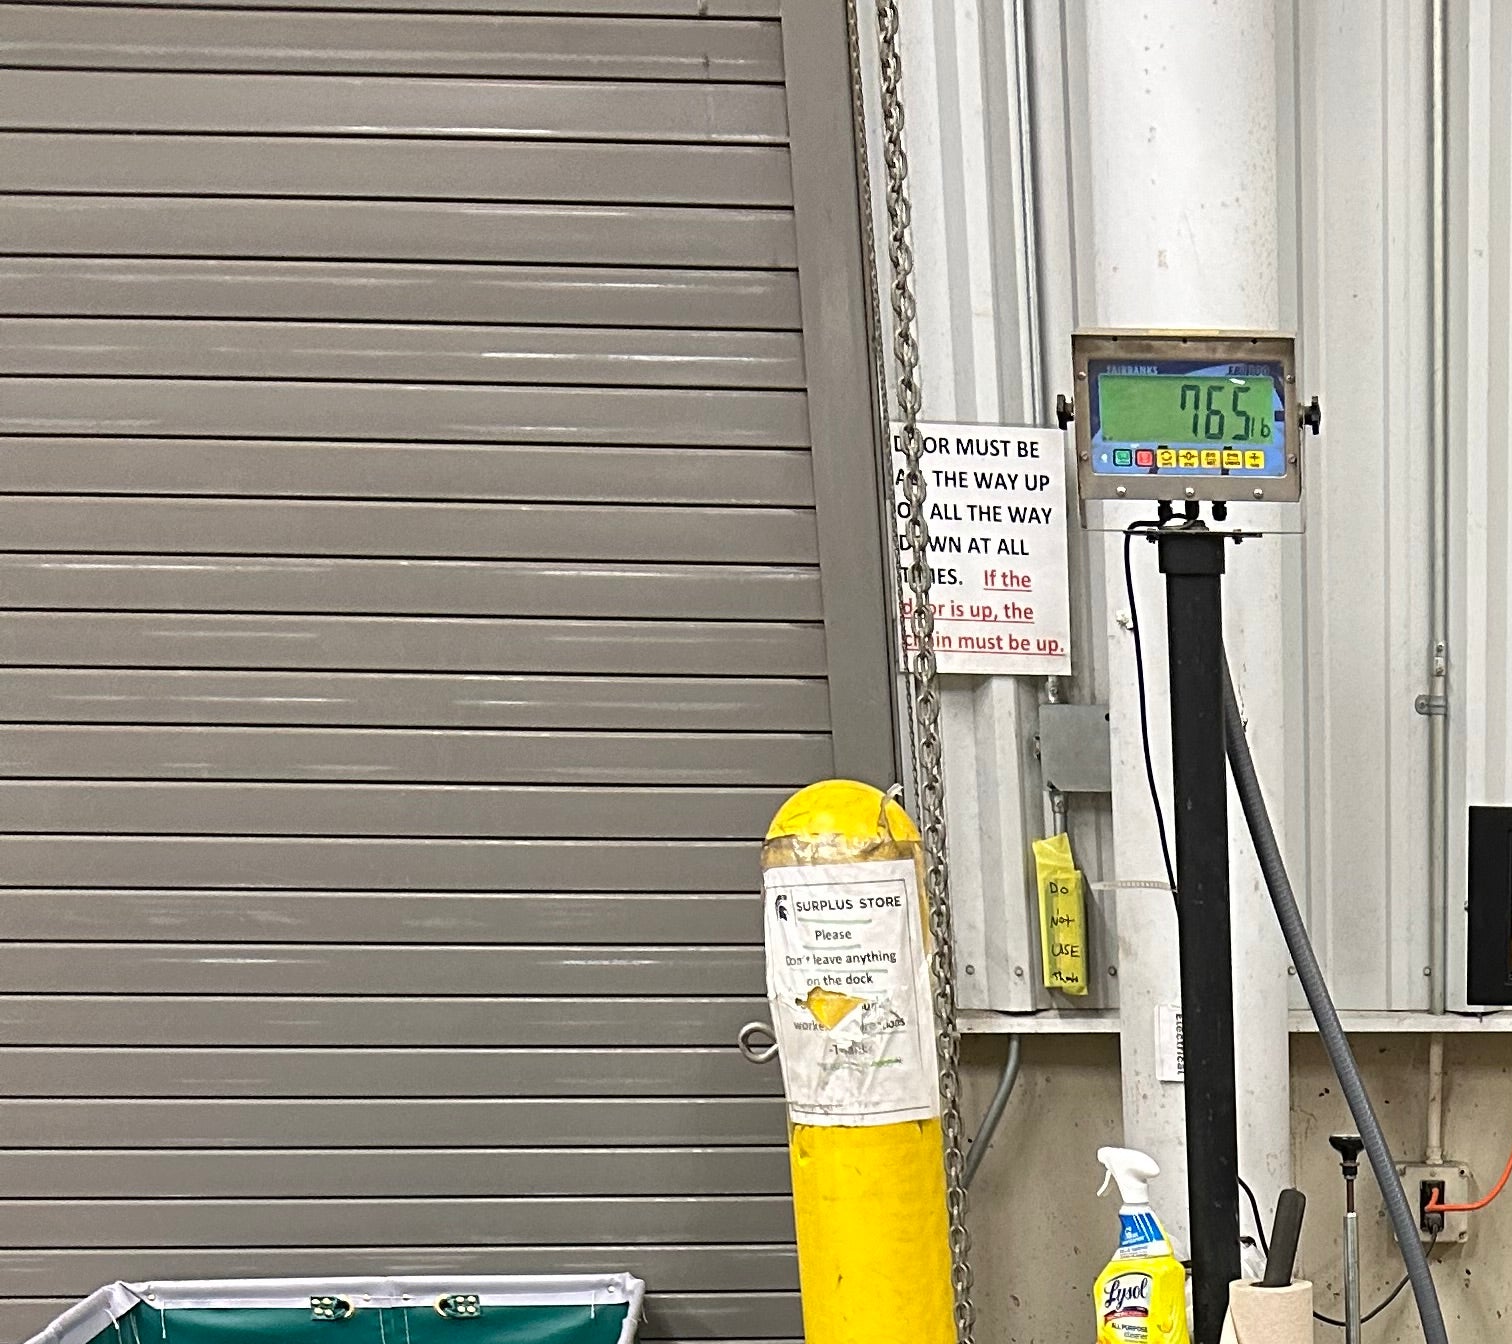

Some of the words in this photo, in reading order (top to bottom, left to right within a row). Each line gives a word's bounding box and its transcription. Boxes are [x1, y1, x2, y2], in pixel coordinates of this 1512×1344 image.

[1106, 364, 1158, 375] FAIRBANKS
[1180, 384, 1250, 441] 765
[893, 435, 950, 455] DOR
[956, 438, 1012, 457] MUST
[1017, 440, 1040, 458] BE
[932, 470, 969, 488] THE
[974, 472, 1019, 491] WAY
[1025, 474, 1050, 491] UP
[930, 503, 963, 521] ALL
[967, 505, 1003, 523] THE
[1008, 506, 1053, 525] WAY
[899, 535, 962, 554] DWN
[967, 537, 991, 554] AT
[997, 538, 1030, 556] ALL
[900, 567, 963, 586] TES.
[984, 569, 997, 588] If
[1001, 571, 1032, 588] the
[903, 598, 946, 617] dor
[951, 599, 965, 617] is
[970, 605, 999, 622] up,
[1004, 602, 1034, 620] the
[958, 634, 1004, 651] must
[1008, 635, 1031, 652] be
[1036, 639, 1065, 656] up.
[1049, 882, 1069, 895] Do
[796, 899, 853, 912] SURPLUS
[860, 895, 902, 909] STORE
[1050, 913, 1074, 929] Not
[815, 929, 852, 941] Please
[813, 953, 842, 966] leave
[845, 951, 897, 965] anything
[1051, 943, 1080, 959] USE
[806, 977, 821, 987] on
[823, 974, 842, 986] the
[846, 971, 874, 985] dock
[1104, 1277, 1148, 1310] Lysol
